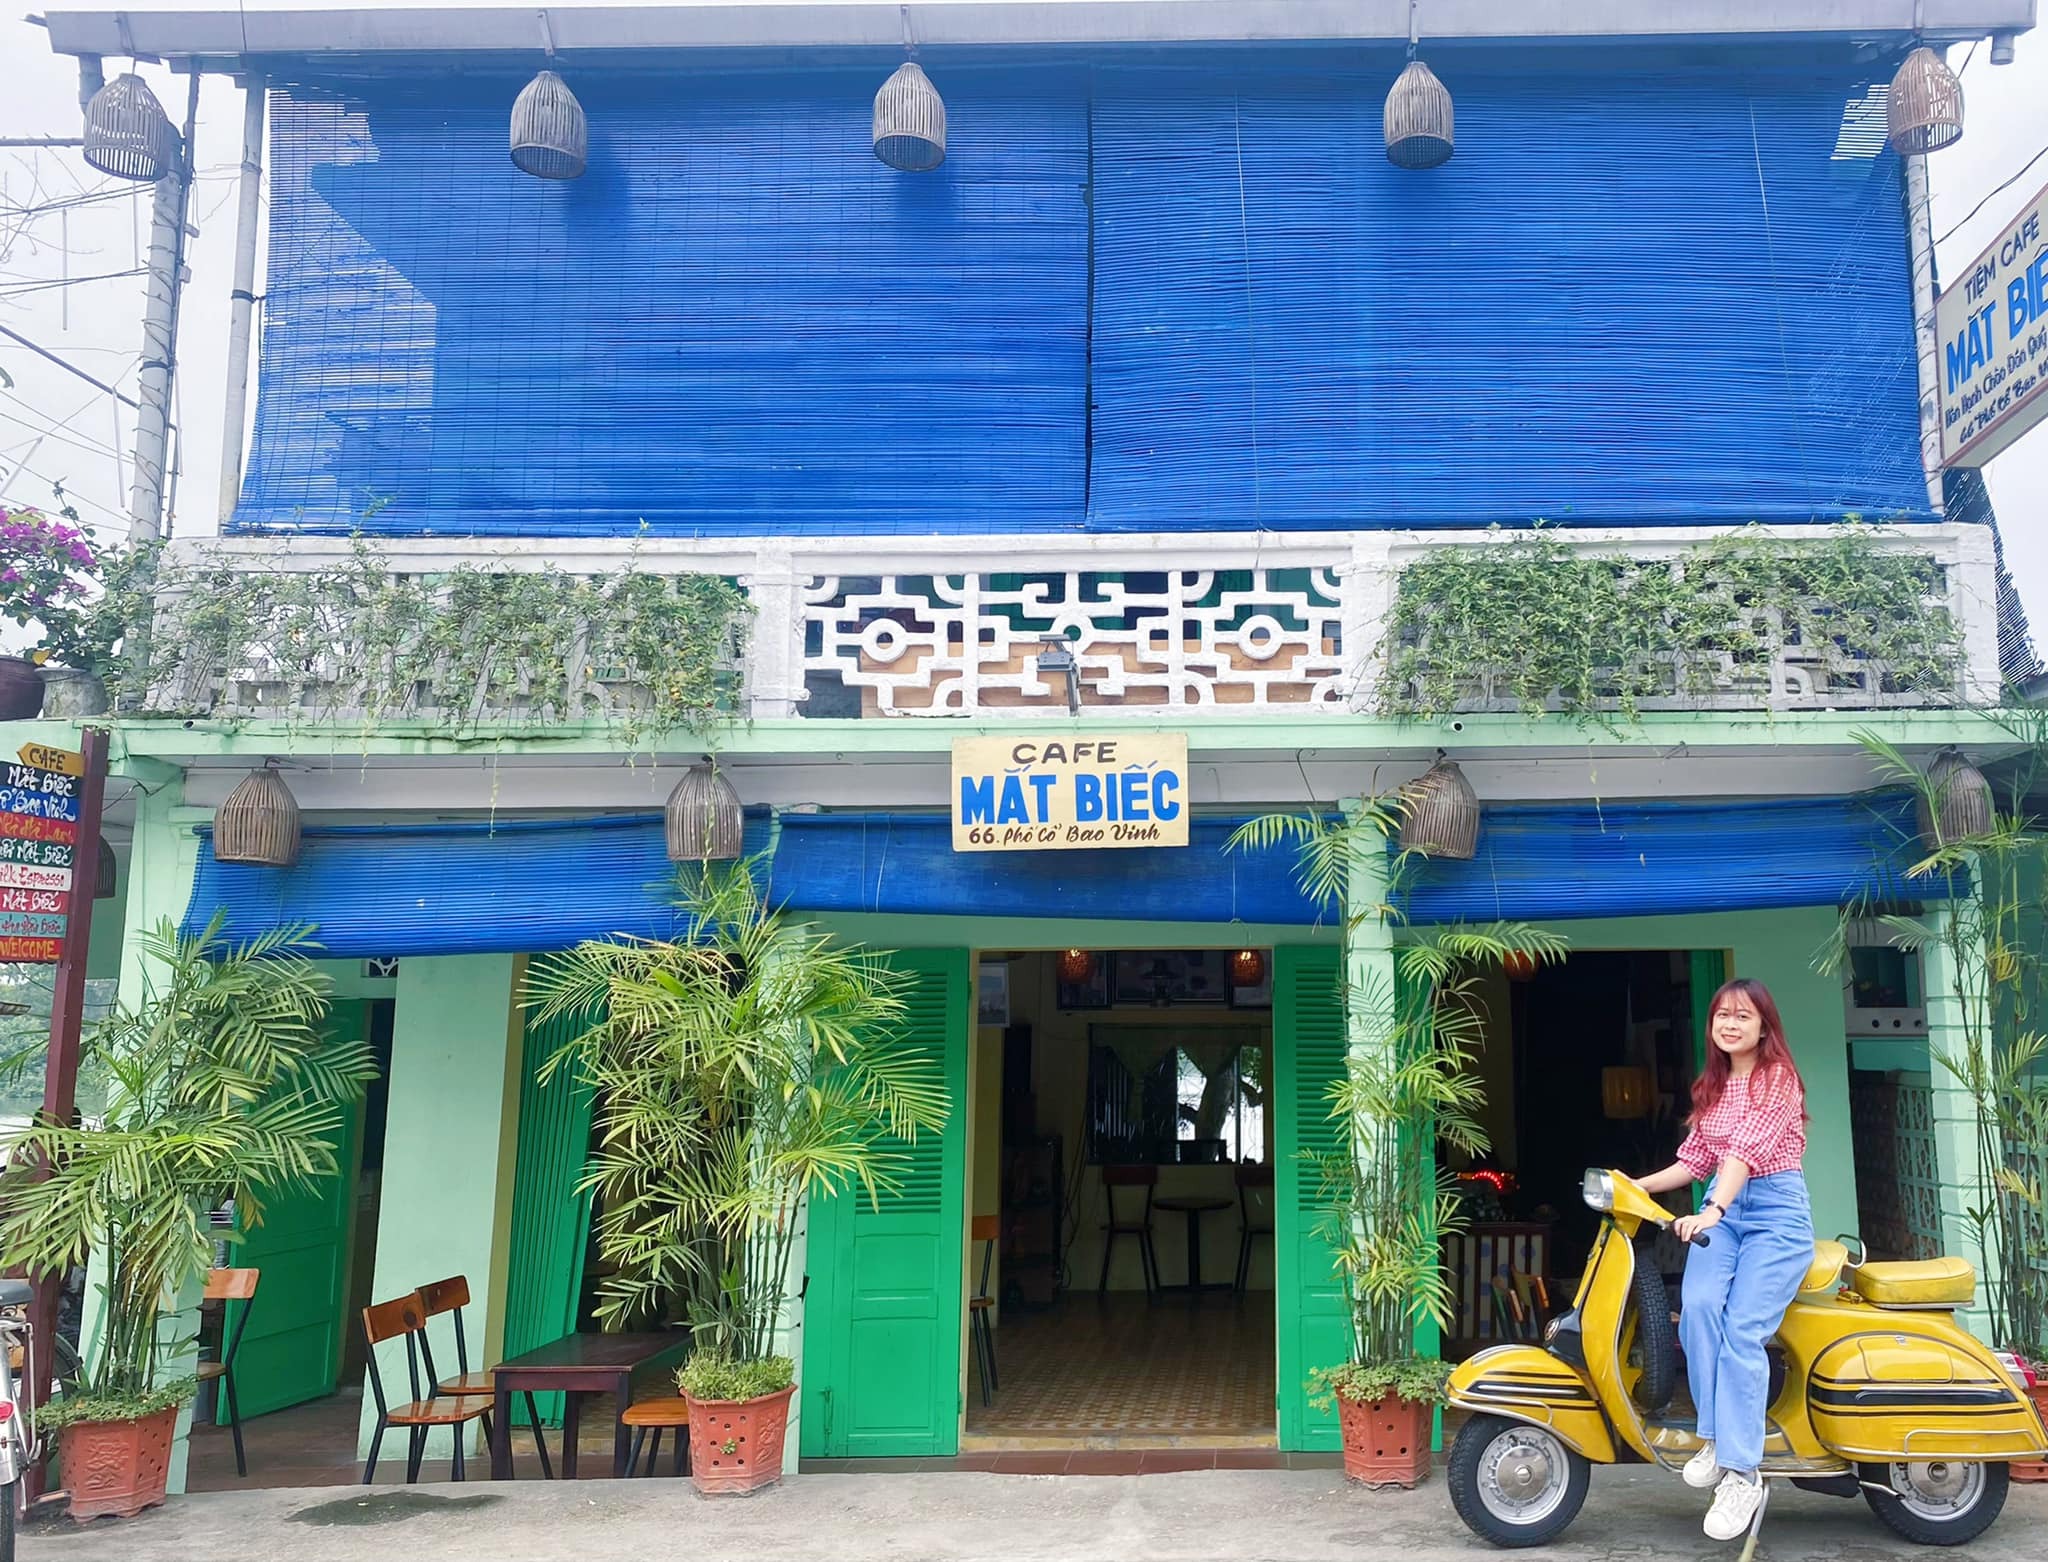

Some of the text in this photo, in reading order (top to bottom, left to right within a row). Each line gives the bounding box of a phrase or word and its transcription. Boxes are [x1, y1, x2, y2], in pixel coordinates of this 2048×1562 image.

[1964, 209, 2040, 305] TIỆM CAFE
[29, 747, 66, 771] CAFE
[1012, 742, 1118, 764] CAFE
[7, 766, 40, 791] Mắt
[961, 760, 1180, 826] MẮT BIẾC
[1066, 826, 1104, 842] Bao
[1110, 823, 1160, 841] Vinh
